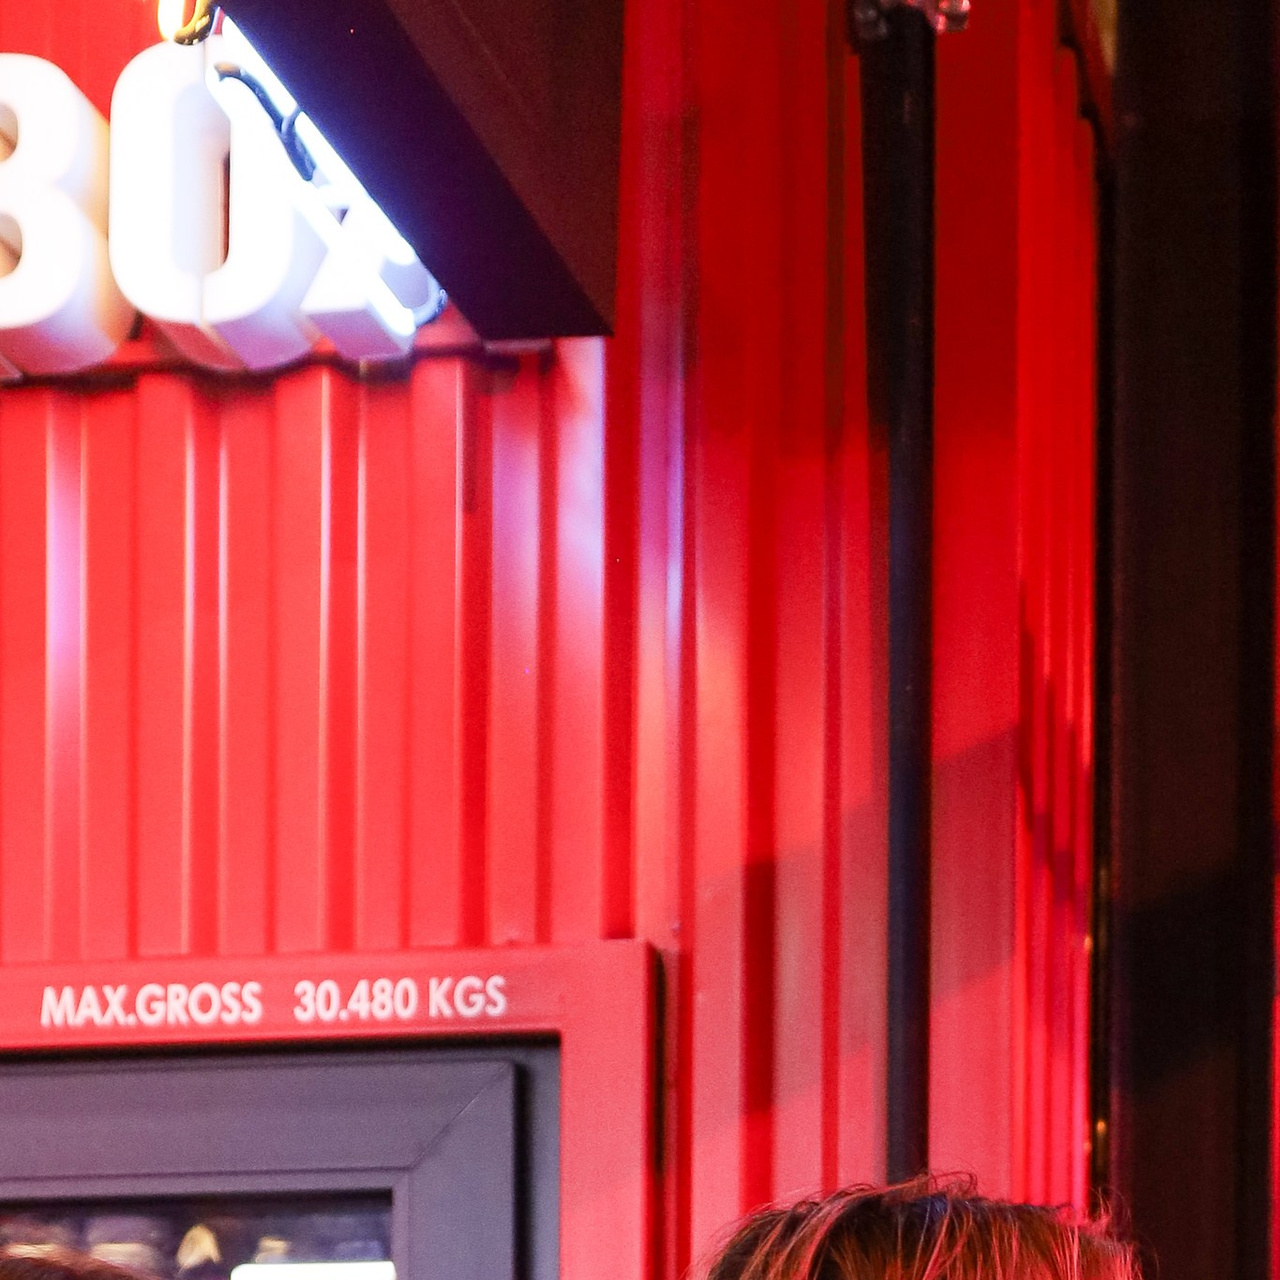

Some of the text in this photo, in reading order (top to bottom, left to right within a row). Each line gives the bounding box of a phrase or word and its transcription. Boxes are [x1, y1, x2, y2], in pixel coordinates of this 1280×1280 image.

[40, 974, 508, 1027] MAX.GROSS 30.480 KGS
